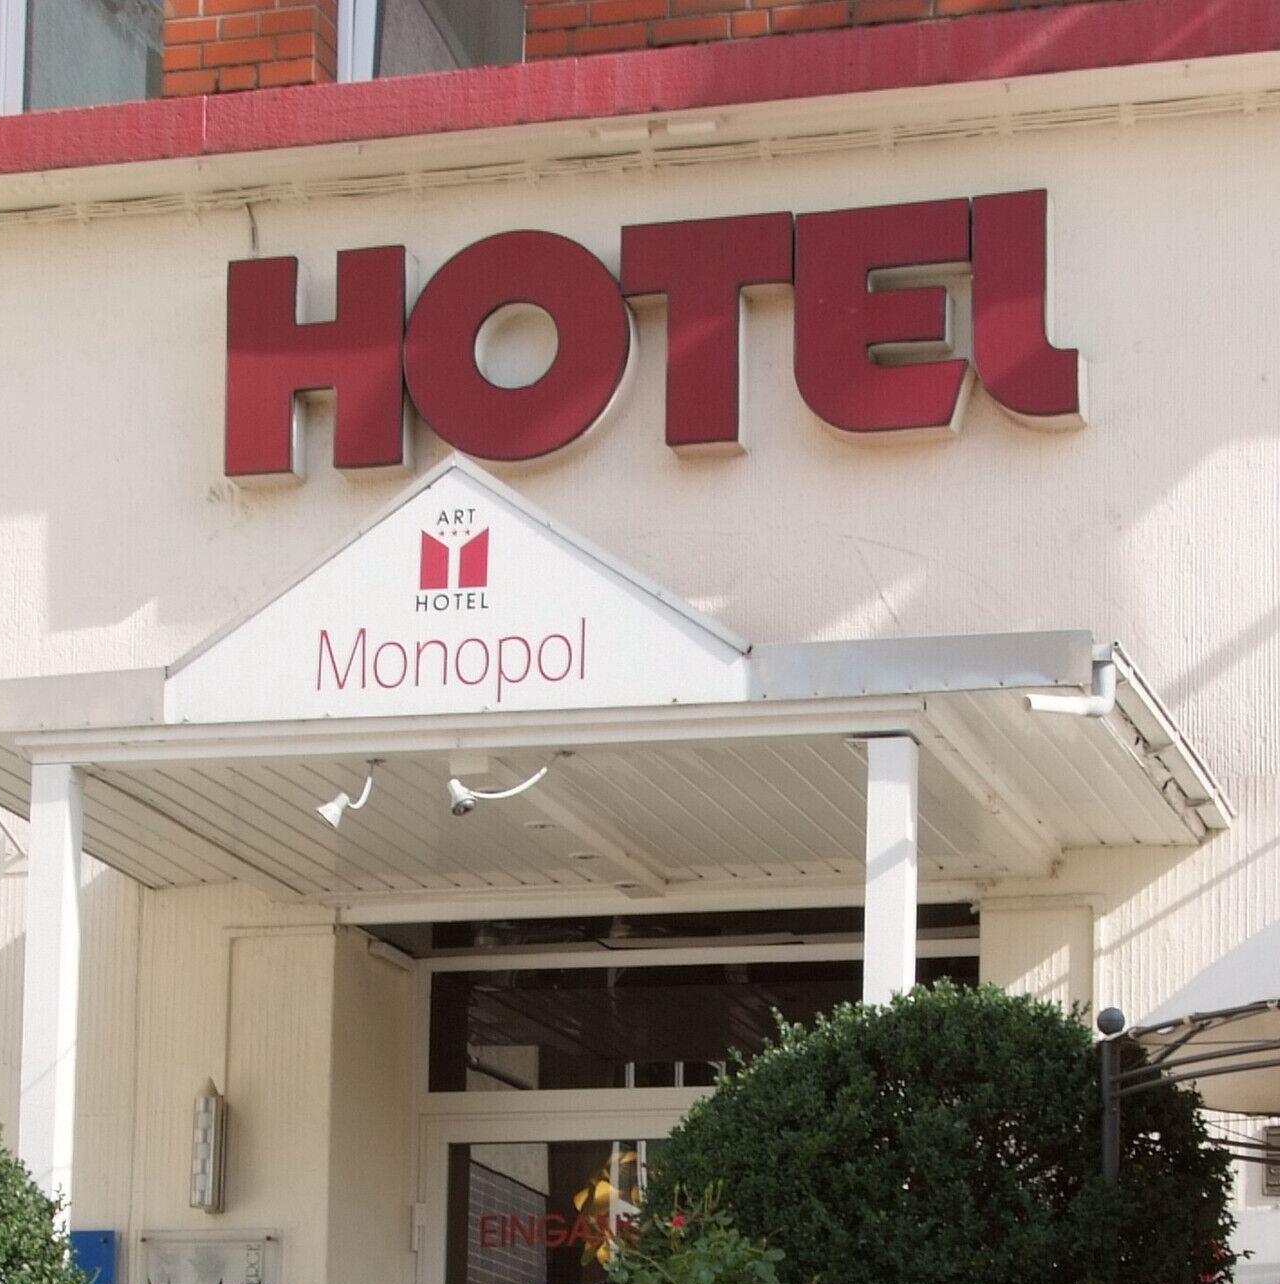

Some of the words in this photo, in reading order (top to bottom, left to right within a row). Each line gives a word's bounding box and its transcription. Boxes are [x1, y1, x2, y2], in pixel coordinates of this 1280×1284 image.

[224, 189, 1080, 480] HOTEL
[436, 508, 476, 526] ART
[415, 591, 490, 612] HOTEL
[316, 617, 587, 703] Monopol
[479, 1213, 642, 1249] EINGA
